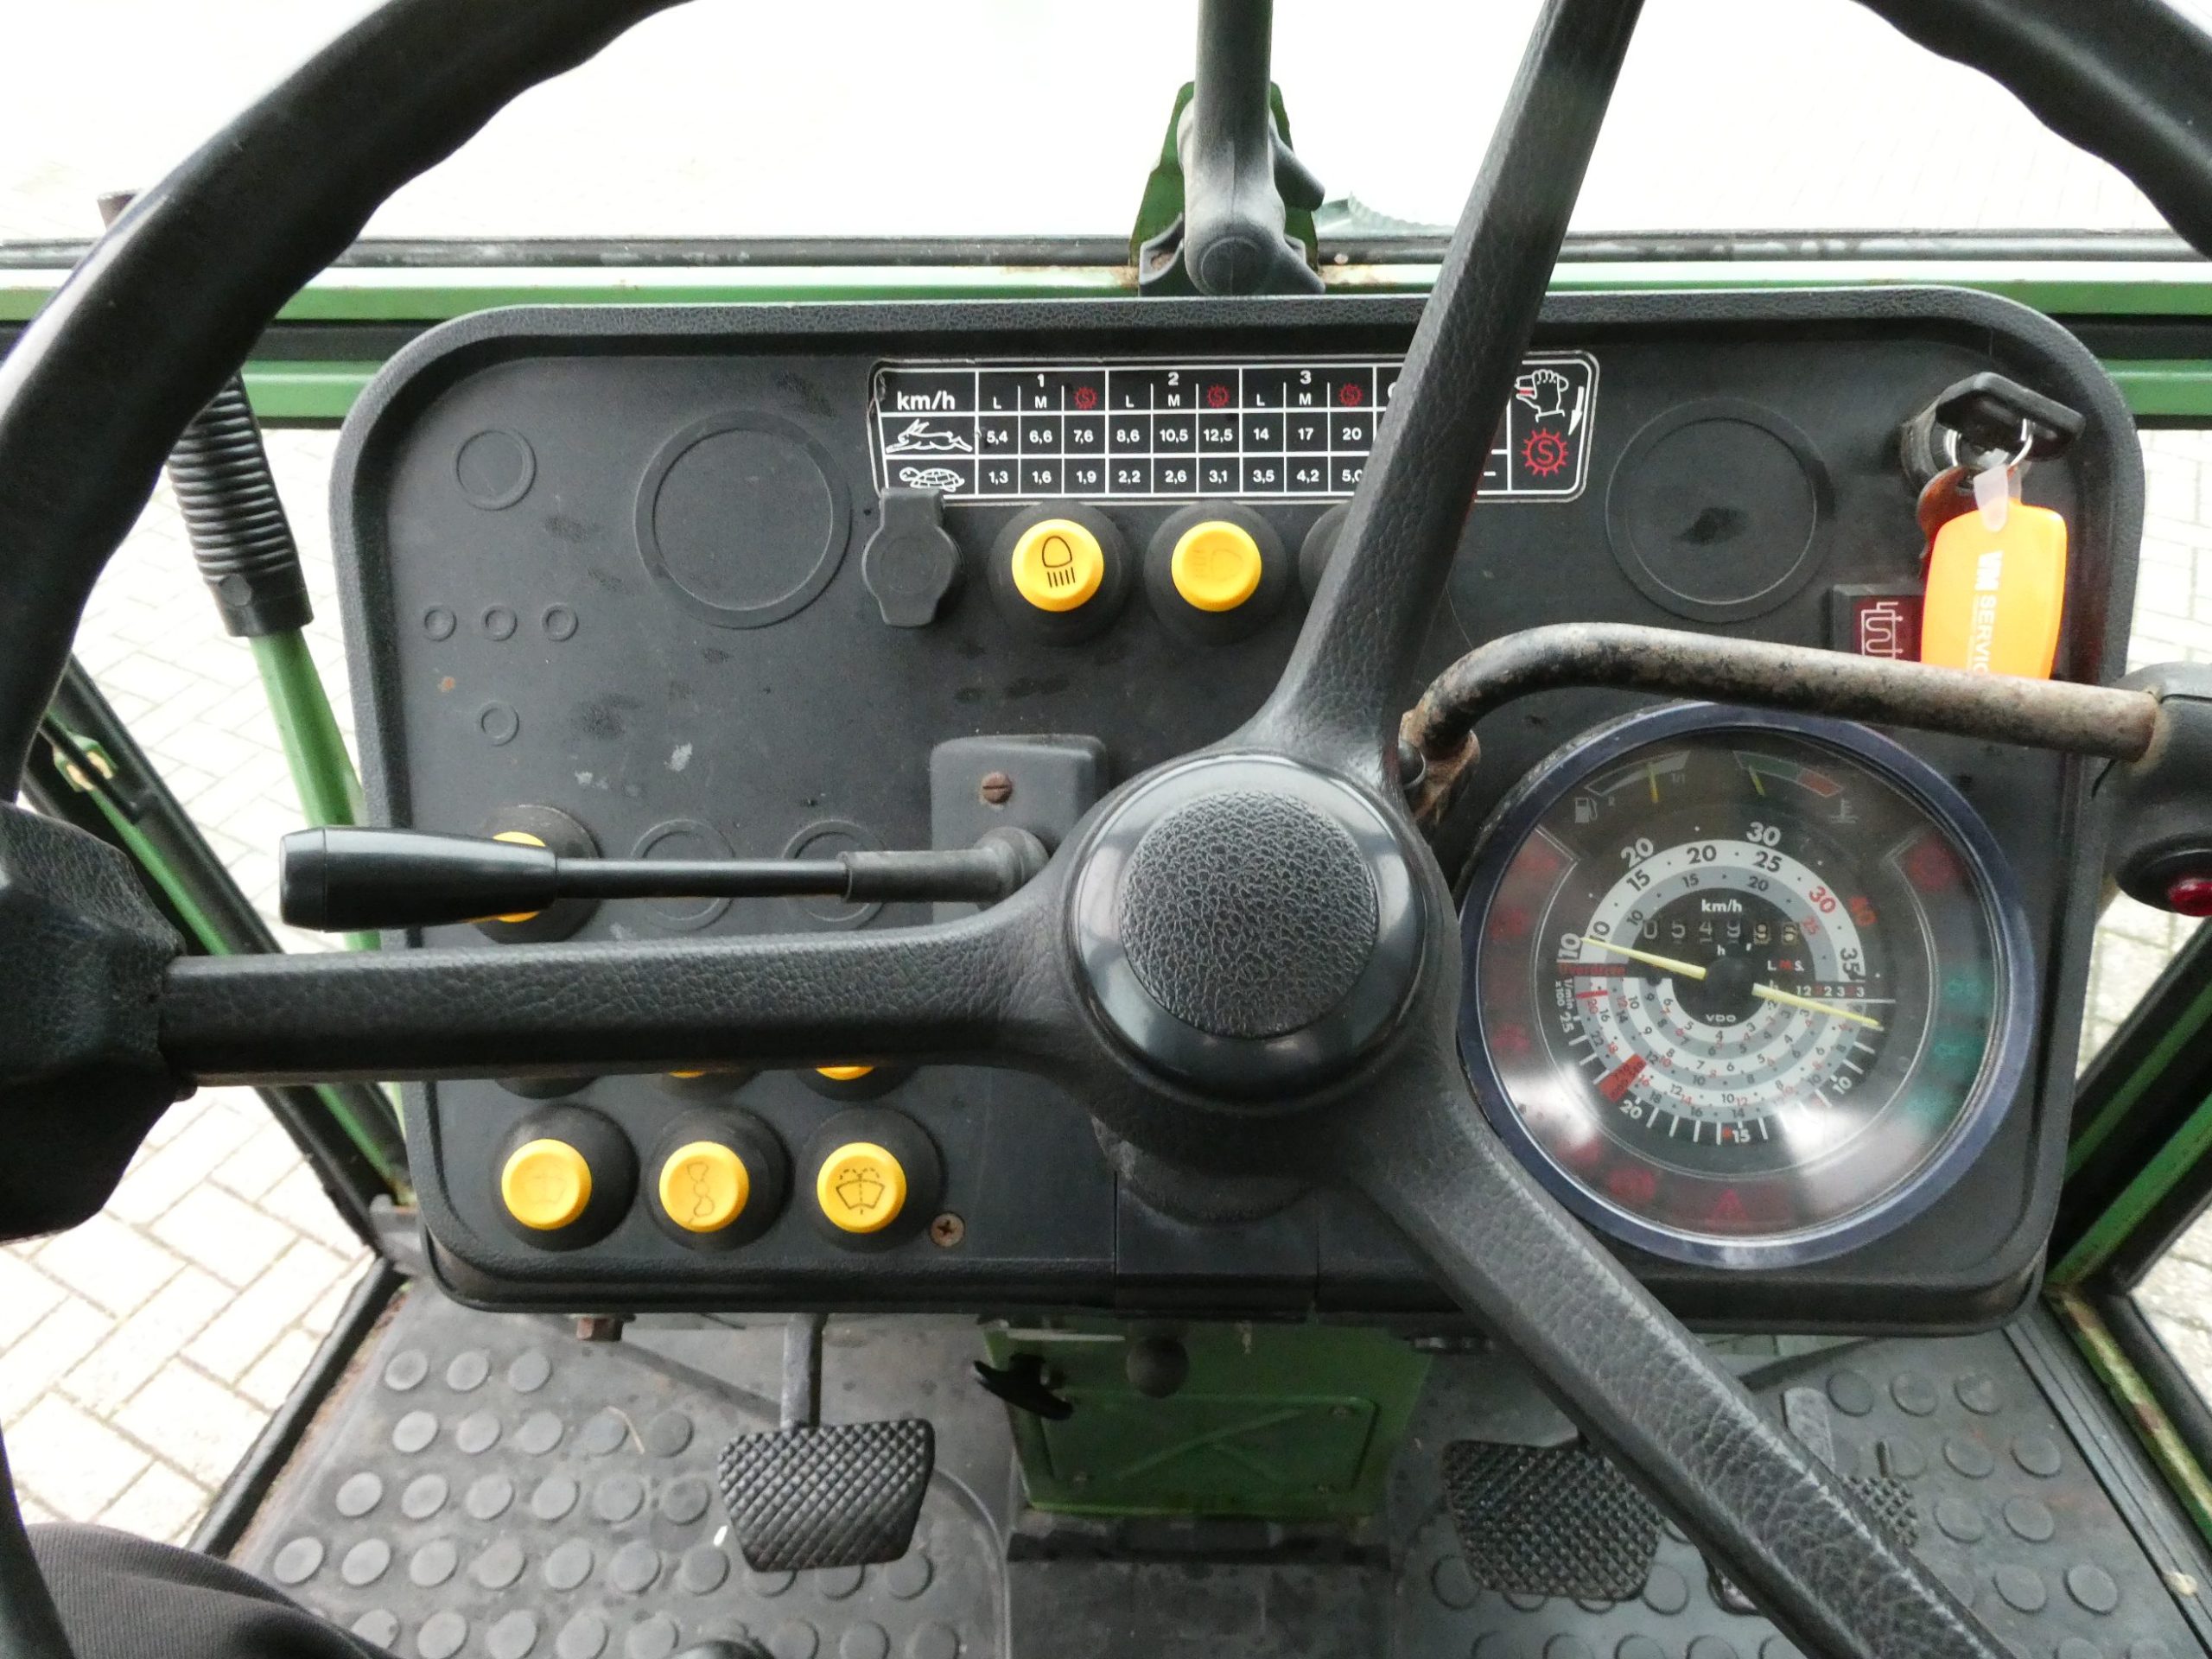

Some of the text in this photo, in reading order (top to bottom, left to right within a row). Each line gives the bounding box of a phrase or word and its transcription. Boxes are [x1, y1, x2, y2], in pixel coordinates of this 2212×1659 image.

[1038, 371, 1311, 387] 1 2 3
[897, 391, 955, 410] km/h
[993, 397, 1001, 409] L
[1035, 396, 1047, 409] M
[1126, 395, 1134, 408] L
[1168, 394, 1179, 407] M
[1256, 394, 1265, 406] L
[1300, 393, 1311, 405] M
[987, 428, 1362, 445] 5,4 6,6 7,6 8,6 10,5 12,5 14 17 20
[988, 471, 1008, 485] 1,3
[1032, 470, 1052, 485] 1,6
[1077, 470, 1096, 485] 1,9
[1118, 470, 1141, 484] 2,2
[1165, 470, 1187, 484] 2,6
[1209, 470, 1227, 484] 3,1
[1253, 469, 1274, 484] 3,5
[1297, 469, 1319, 484] 4,2
[1625, 868, 1651, 892] 15
[1687, 845, 1717, 864] 20
[1752, 851, 1783, 872] 25
[1808, 886, 1836, 914] 30
[1558, 933, 1581, 963] 10
[1621, 837, 1655, 868] 20
[1747, 822, 1782, 847] 30
[1626, 909, 1644, 926] 10
[1682, 874, 1700, 887] 15
[1748, 876, 1770, 892] 20
[1701, 899, 1742, 913] km/h
[1705, 1014, 1737, 1023] VDO
[1629, 995, 1640, 1009] 10
[1666, 1048, 1675, 1058] 8
[1697, 1059, 1705, 1070] 7
[1726, 1062, 1734, 1071] 6
[1757, 1053, 1765, 1064] 5
[1715, 1030, 1723, 1041] 4
[1599, 1009, 1611, 1022] 16
[1670, 1084, 1682, 1096] 12
[1721, 1092, 1735, 1103] 10
[1815, 1046, 1825, 1055] 6
[1560, 1011, 1852, 1143] 25 20 15 10
[1693, 1074, 1706, 1086] 10
